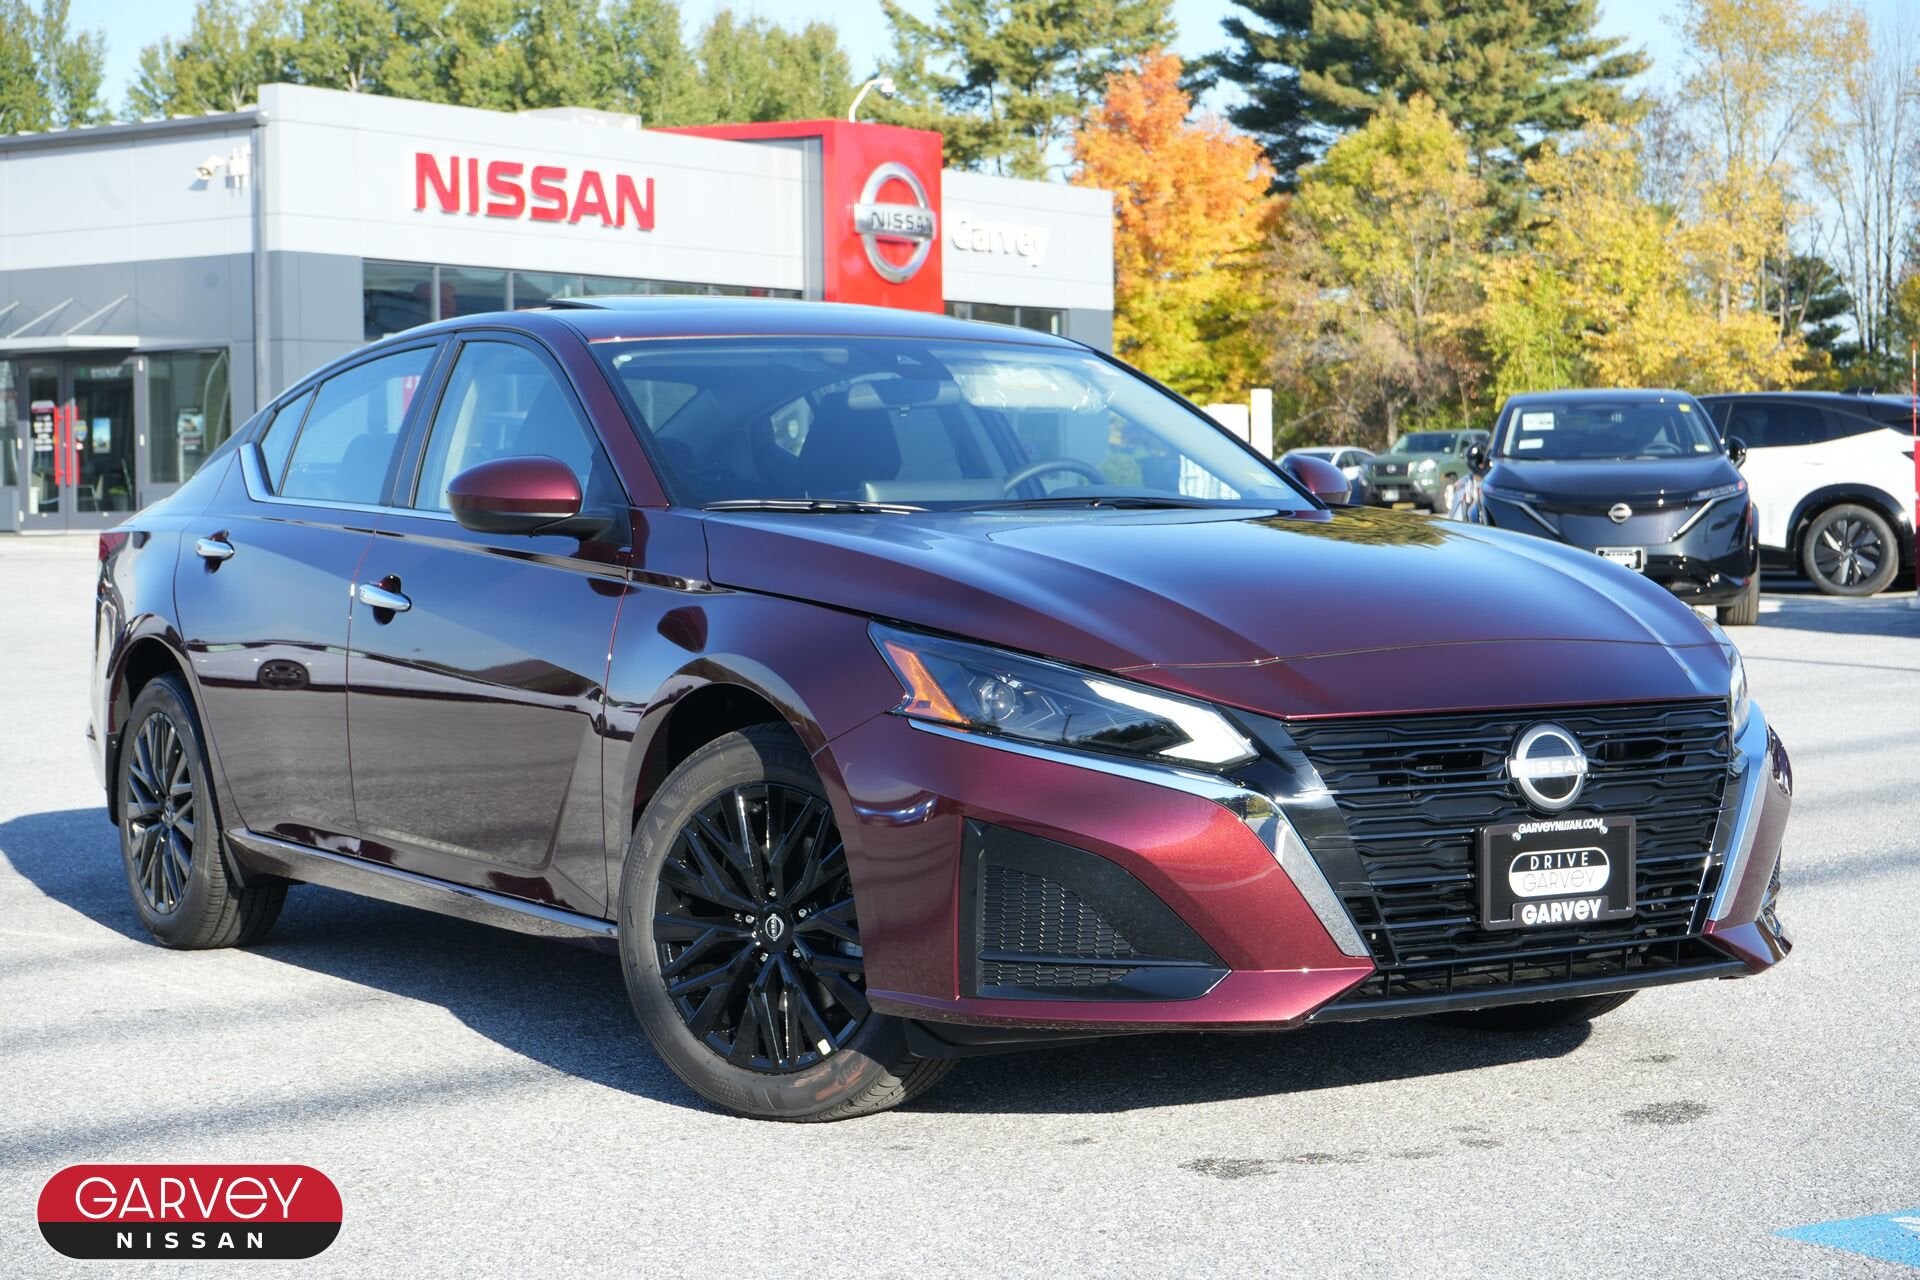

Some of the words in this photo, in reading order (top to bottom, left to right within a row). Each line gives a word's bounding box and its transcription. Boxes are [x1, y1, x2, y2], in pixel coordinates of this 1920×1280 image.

[415, 153, 655, 230] NISSAN
[871, 212, 932, 234] NISSAN
[1530, 851, 1589, 871] DRIVE
[1523, 869, 1595, 892] GARVEY
[1521, 898, 1602, 925] GARVEY
